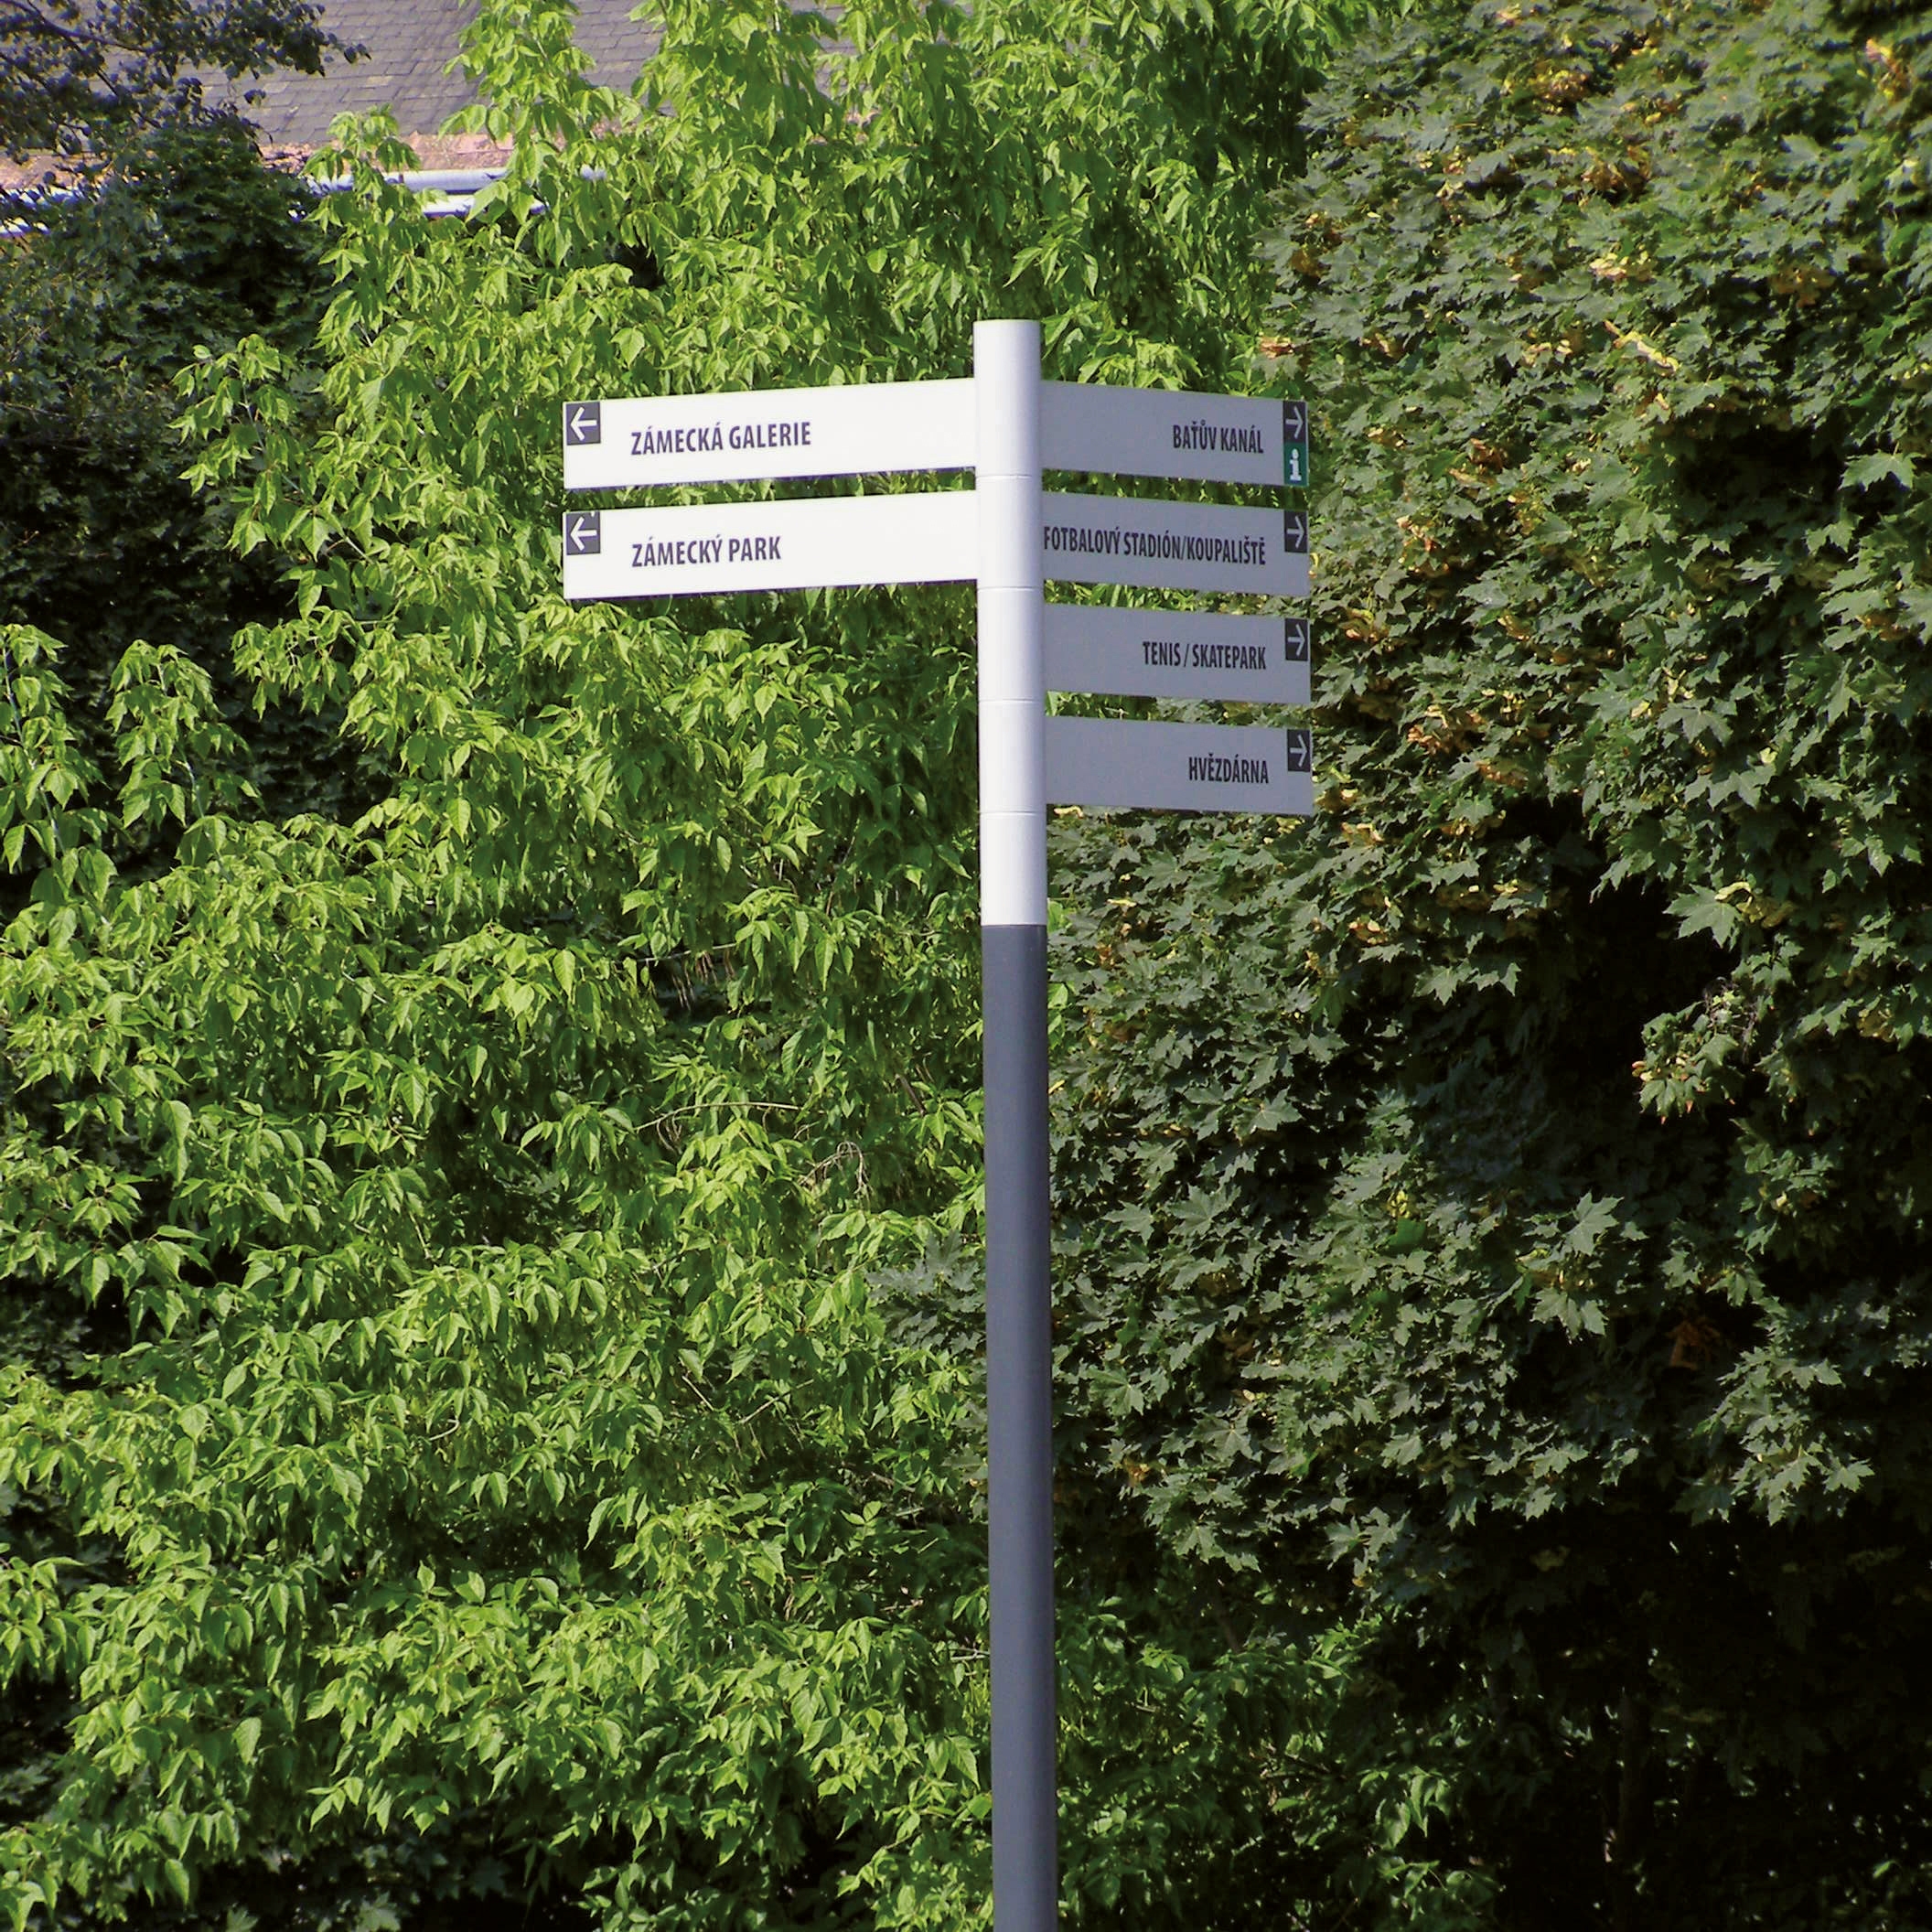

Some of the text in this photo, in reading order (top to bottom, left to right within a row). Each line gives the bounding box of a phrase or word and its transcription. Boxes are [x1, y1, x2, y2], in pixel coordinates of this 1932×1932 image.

[631, 422, 811, 456] ZÁMECKÁ GALERIE
[1172, 419, 1264, 455] BAŤŮV KANÁL
[631, 534, 781, 567] ZÁMECKÝ PARK
[1043, 525, 1121, 555] FOTBALOVÝ
[1142, 640, 1182, 667] TENIS
[1192, 643, 1267, 671] SKATEPARK
[1188, 752, 1270, 785] HVĚZDÁRNA
